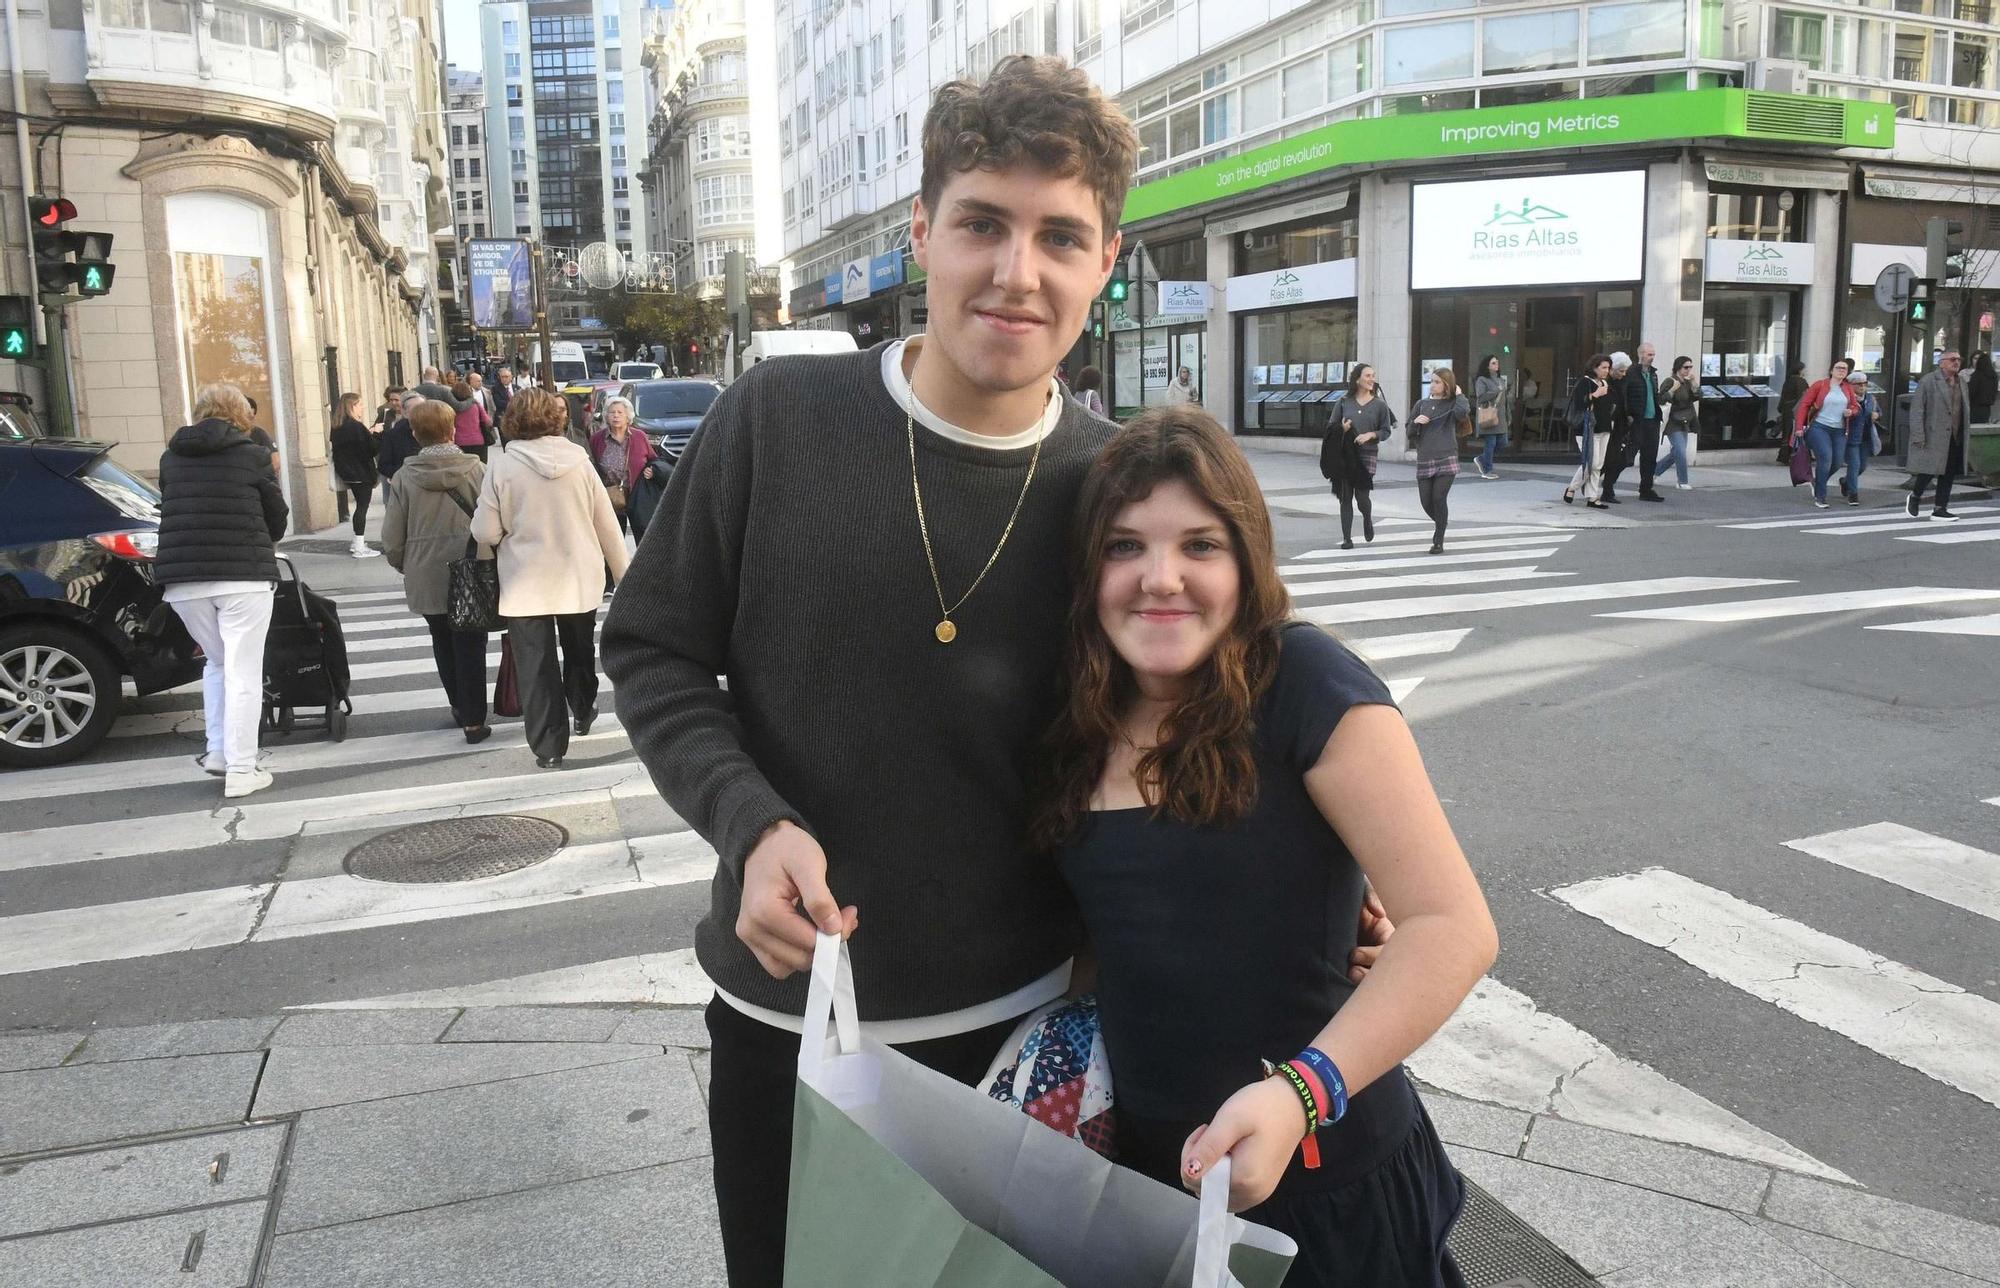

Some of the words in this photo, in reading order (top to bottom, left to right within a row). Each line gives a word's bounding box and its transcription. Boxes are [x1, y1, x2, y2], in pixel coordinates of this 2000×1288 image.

[1441, 120, 1540, 143] Improving
[1547, 113, 1620, 133] Metrics
[1217, 172, 1235, 187] Join
[1236, 166, 1252, 182] the
[1254, 155, 1281, 177] digital
[1283, 142, 1332, 168] revolution
[1737, 167, 1765, 182] Altas
[1525, 228, 1579, 246] Altas
[1762, 263, 1788, 276] Altas
[1286, 287, 1303, 298] Altas
[1185, 297, 1204, 306] Altas
